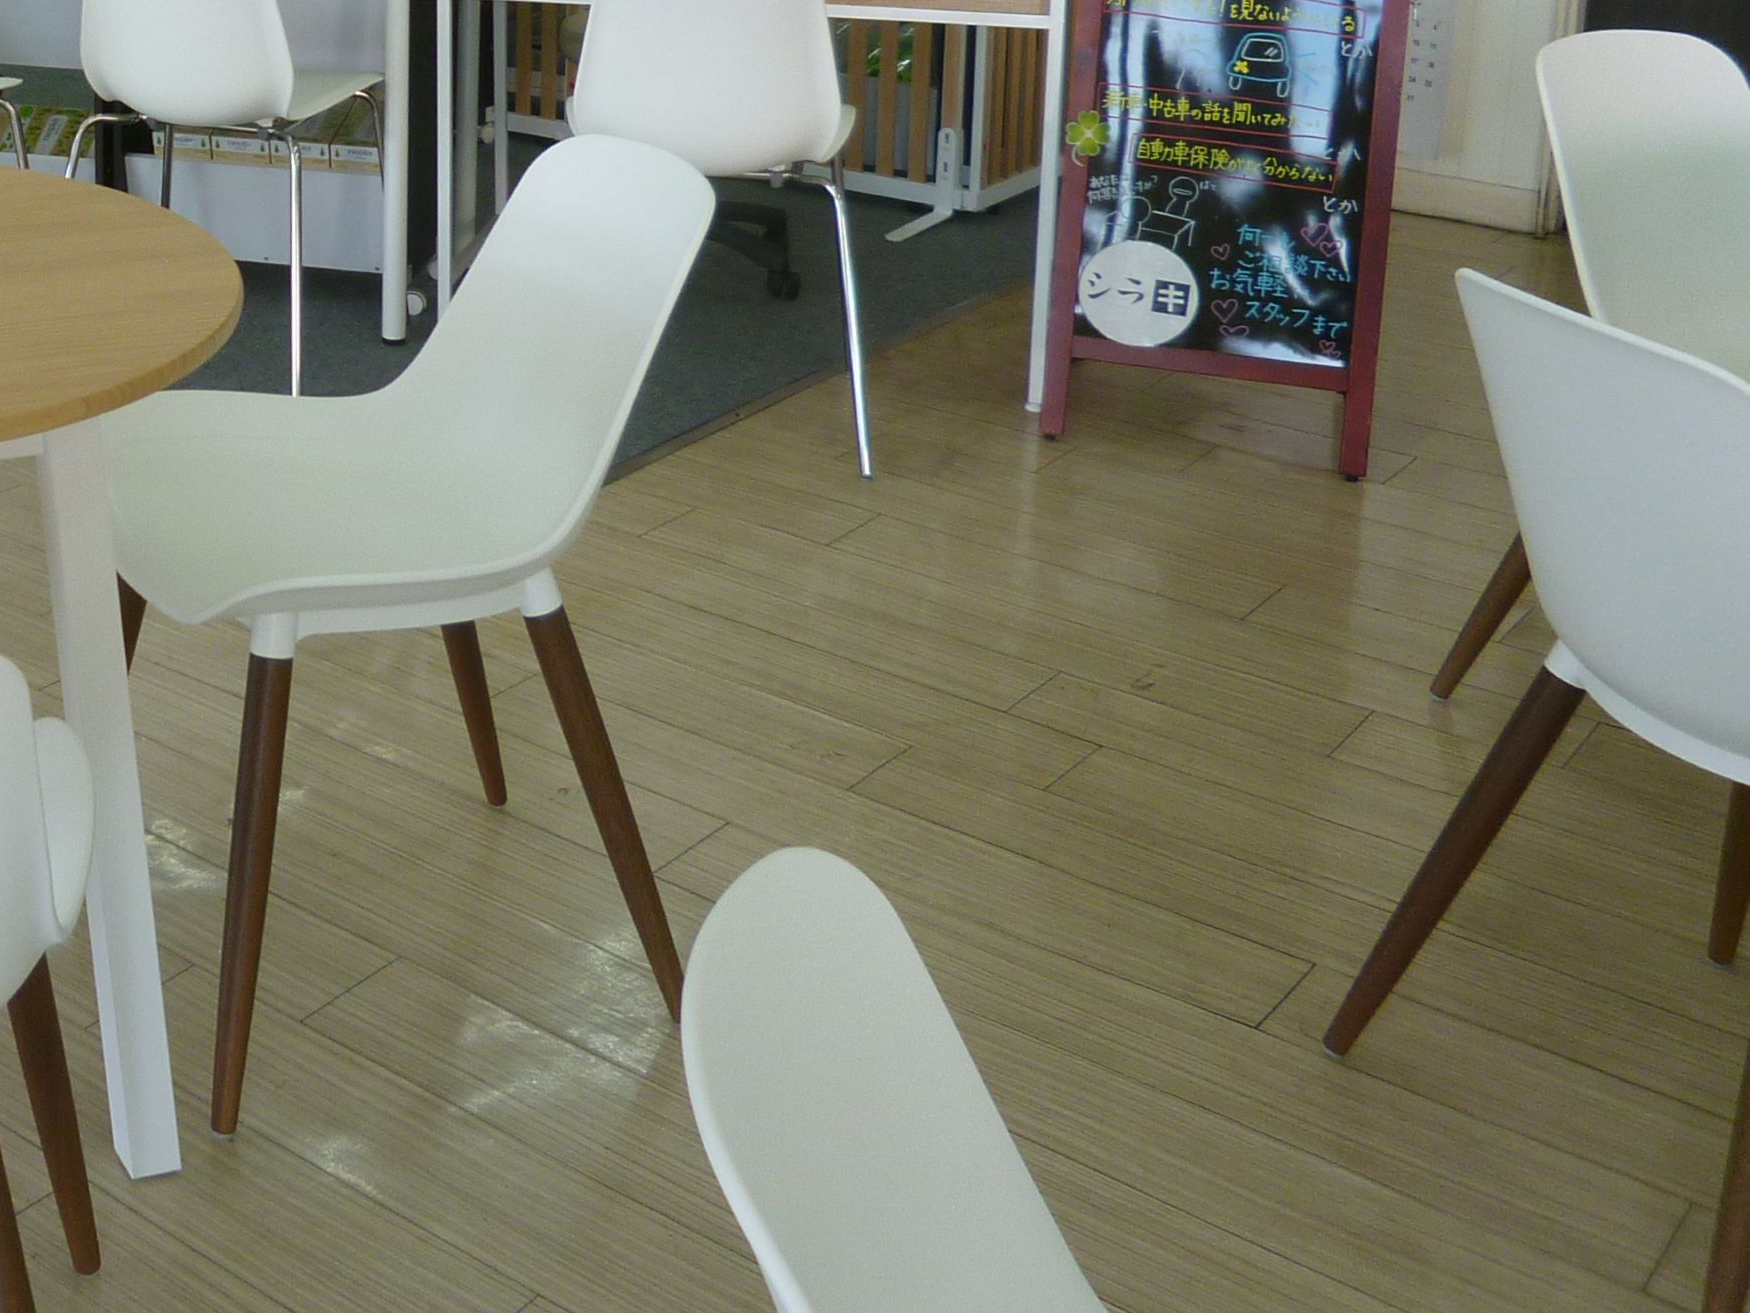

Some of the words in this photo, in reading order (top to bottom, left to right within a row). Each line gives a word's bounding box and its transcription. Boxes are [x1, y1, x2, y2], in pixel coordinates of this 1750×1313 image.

[1340, 42, 1373, 58] とか
[1322, 197, 1359, 214] とか
[1087, 271, 1192, 318] シラキ
[1245, 300, 1348, 338] スタッフまで
